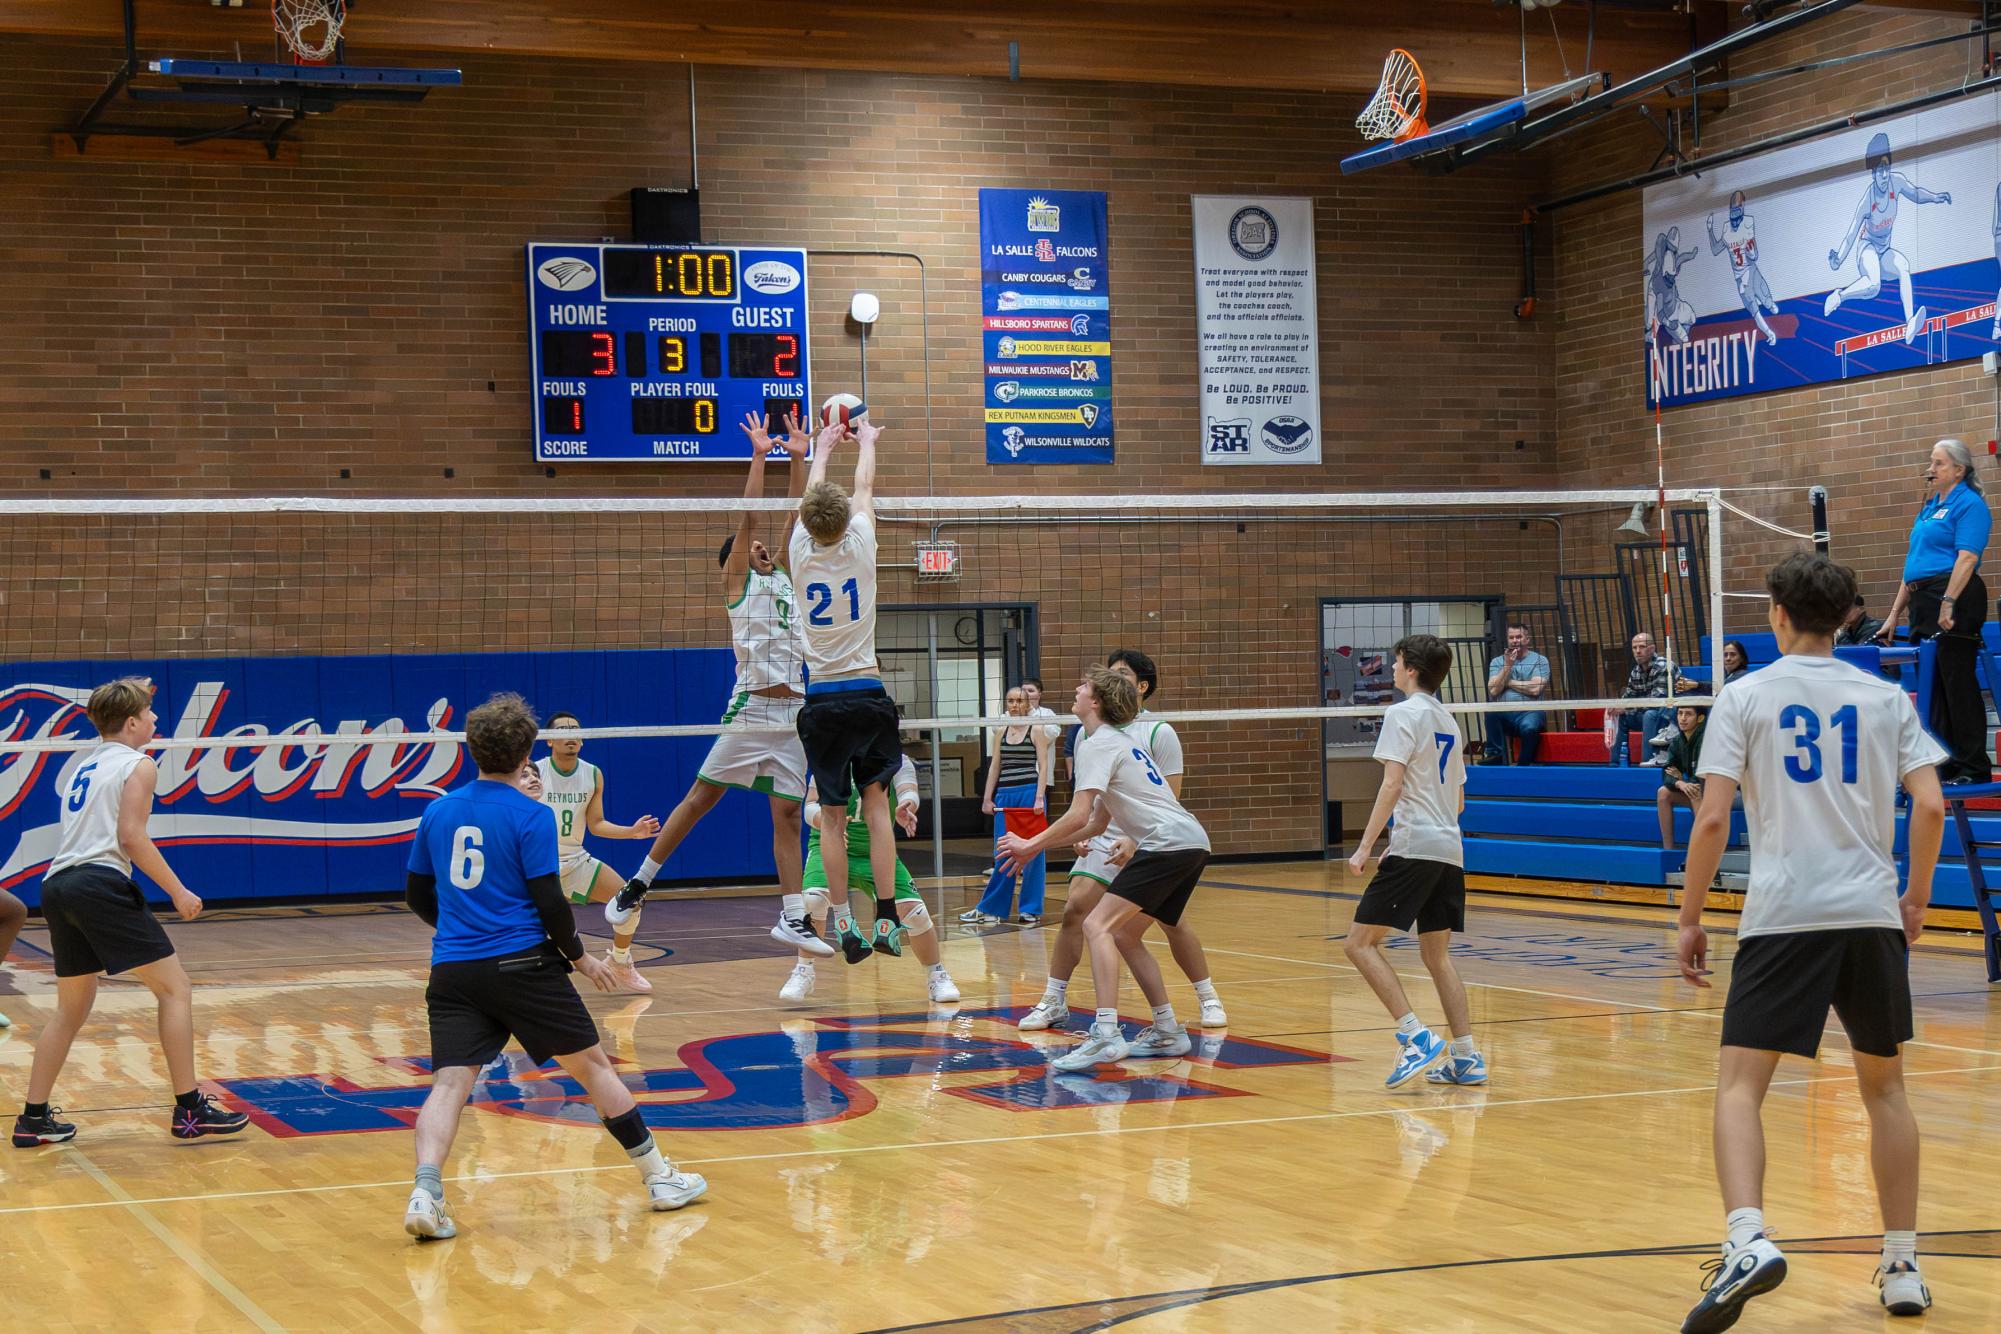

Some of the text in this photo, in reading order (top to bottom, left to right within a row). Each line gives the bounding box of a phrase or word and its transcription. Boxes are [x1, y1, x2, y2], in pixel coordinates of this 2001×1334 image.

[992, 245, 1033, 256] LA SALLE
[1056, 247, 1098, 257] FALCONS
[655, 254, 732, 296] 1:00
[1002, 273, 1066, 283] CANBY COUGARS
[1201, 268, 1220, 276] Treat
[1223, 269, 1258, 278] everyone
[1280, 269, 1308, 277] respect
[1248, 280, 1266, 288] good
[1216, 290, 1228, 298] Let
[1245, 291, 1274, 299] players
[1024, 297, 1097, 307] CENTENNIAL EAGLES
[549, 304, 607, 326] HOME
[732, 307, 794, 328] GUEST
[1237, 313, 1269, 321] officials
[1965, 303, 1997, 321] LA SALL
[649, 317, 697, 332] PERIOD
[989, 319, 1068, 329] HILLSBORO SPARTANS
[1284, 333, 1300, 341] play
[1866, 335, 1878, 346] LA
[592, 333, 613, 376] 3
[1018, 343, 1093, 352] HOOD RIVER EAGLES
[1204, 344, 1237, 352] creating
[1251, 344, 1298, 352] environment
[1300, 344, 1309, 352] of
[665, 338, 683, 372] 3
[774, 335, 797, 377] 2
[1217, 355, 1248, 363] SAFETY,
[989, 365, 1070, 375] MILWAUKIE MUSTANGS
[1203, 366, 1256, 374] ACCEPTANCE,
[1650, 329, 1757, 400] INTEGRITY
[543, 382, 586, 396] FOULS
[631, 382, 719, 396] PLAYER FOUL
[762, 383, 804, 397] FOULS
[1020, 387, 1093, 397] PARKROSE BRONCOS
[1206, 384, 1310, 393] Be LOUD. Be PROUD.
[1226, 395, 1293, 404] Be POSITIVE!
[572, 401, 581, 430] 1
[694, 400, 714, 433] 0
[989, 411, 1076, 420] REX PUTNAM KINGSMEN
[544, 441, 587, 455] SCORE
[653, 441, 699, 455] MATCH
[1024, 437, 1110, 446] WILSONVILLE WILDCATS
[1264, 438, 1309, 452] SPORTSMANSHIP
[926, 551, 948, 570] EXIT
[806, 577, 860, 626] 21
[775, 599, 790, 630] 9
[0, 681, 448, 815] Flcons
[1780, 704, 1858, 784] 31
[1434, 731, 1455, 785] 7
[1132, 748, 1163, 786] 3
[68, 762, 98, 812] 5
[547, 792, 588, 803] REYNOLDS
[561, 809, 573, 837] 8
[450, 825, 485, 890] 6
